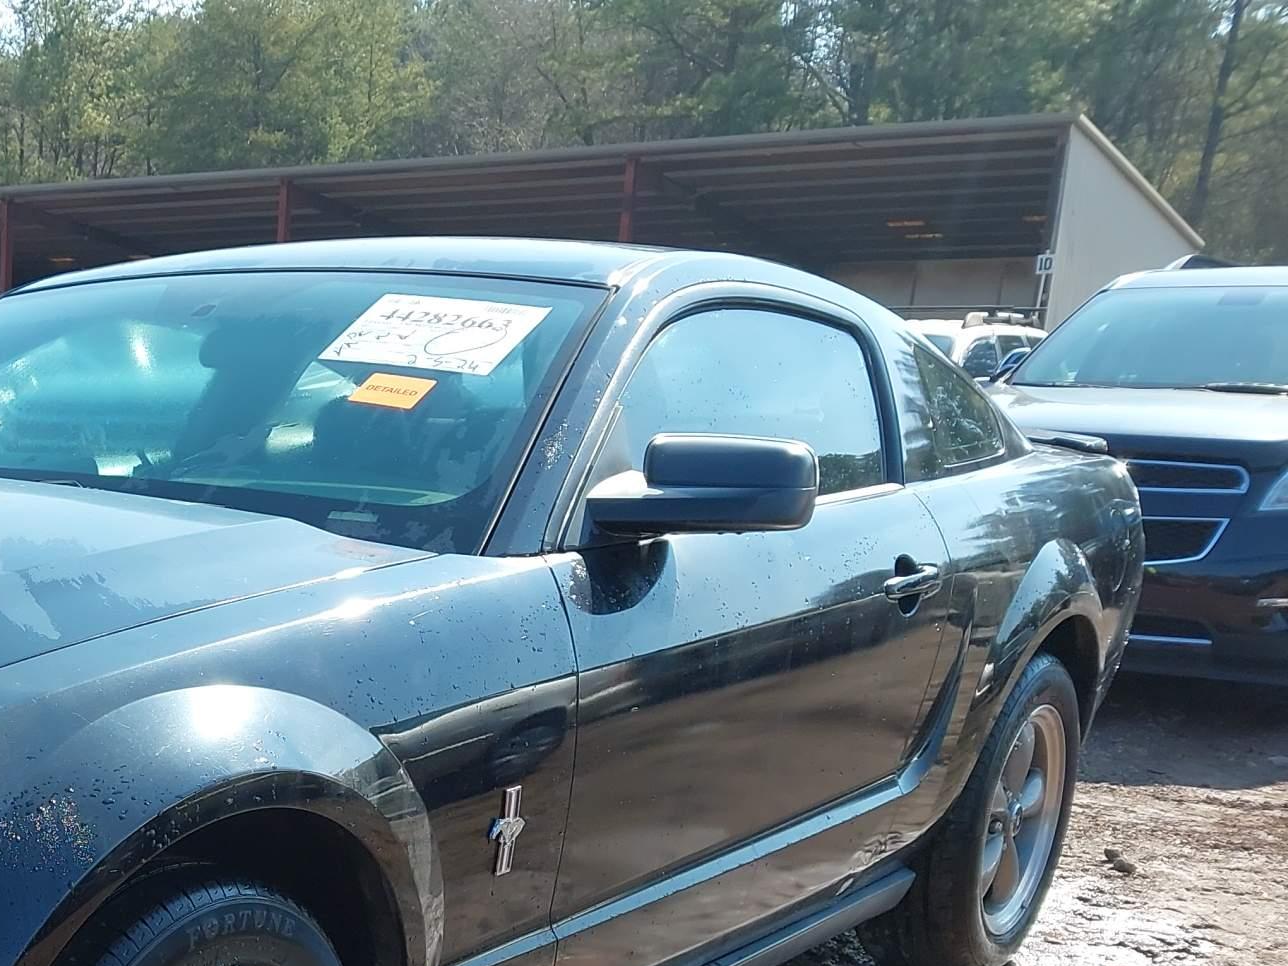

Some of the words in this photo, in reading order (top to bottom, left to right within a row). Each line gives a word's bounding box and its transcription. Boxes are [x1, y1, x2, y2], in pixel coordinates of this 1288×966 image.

[1039, 257, 1054, 272] 10
[379, 308, 513, 333] 44282663
[365, 384, 418, 397] DETAILED
[185, 910, 298, 952] FORTUNE
